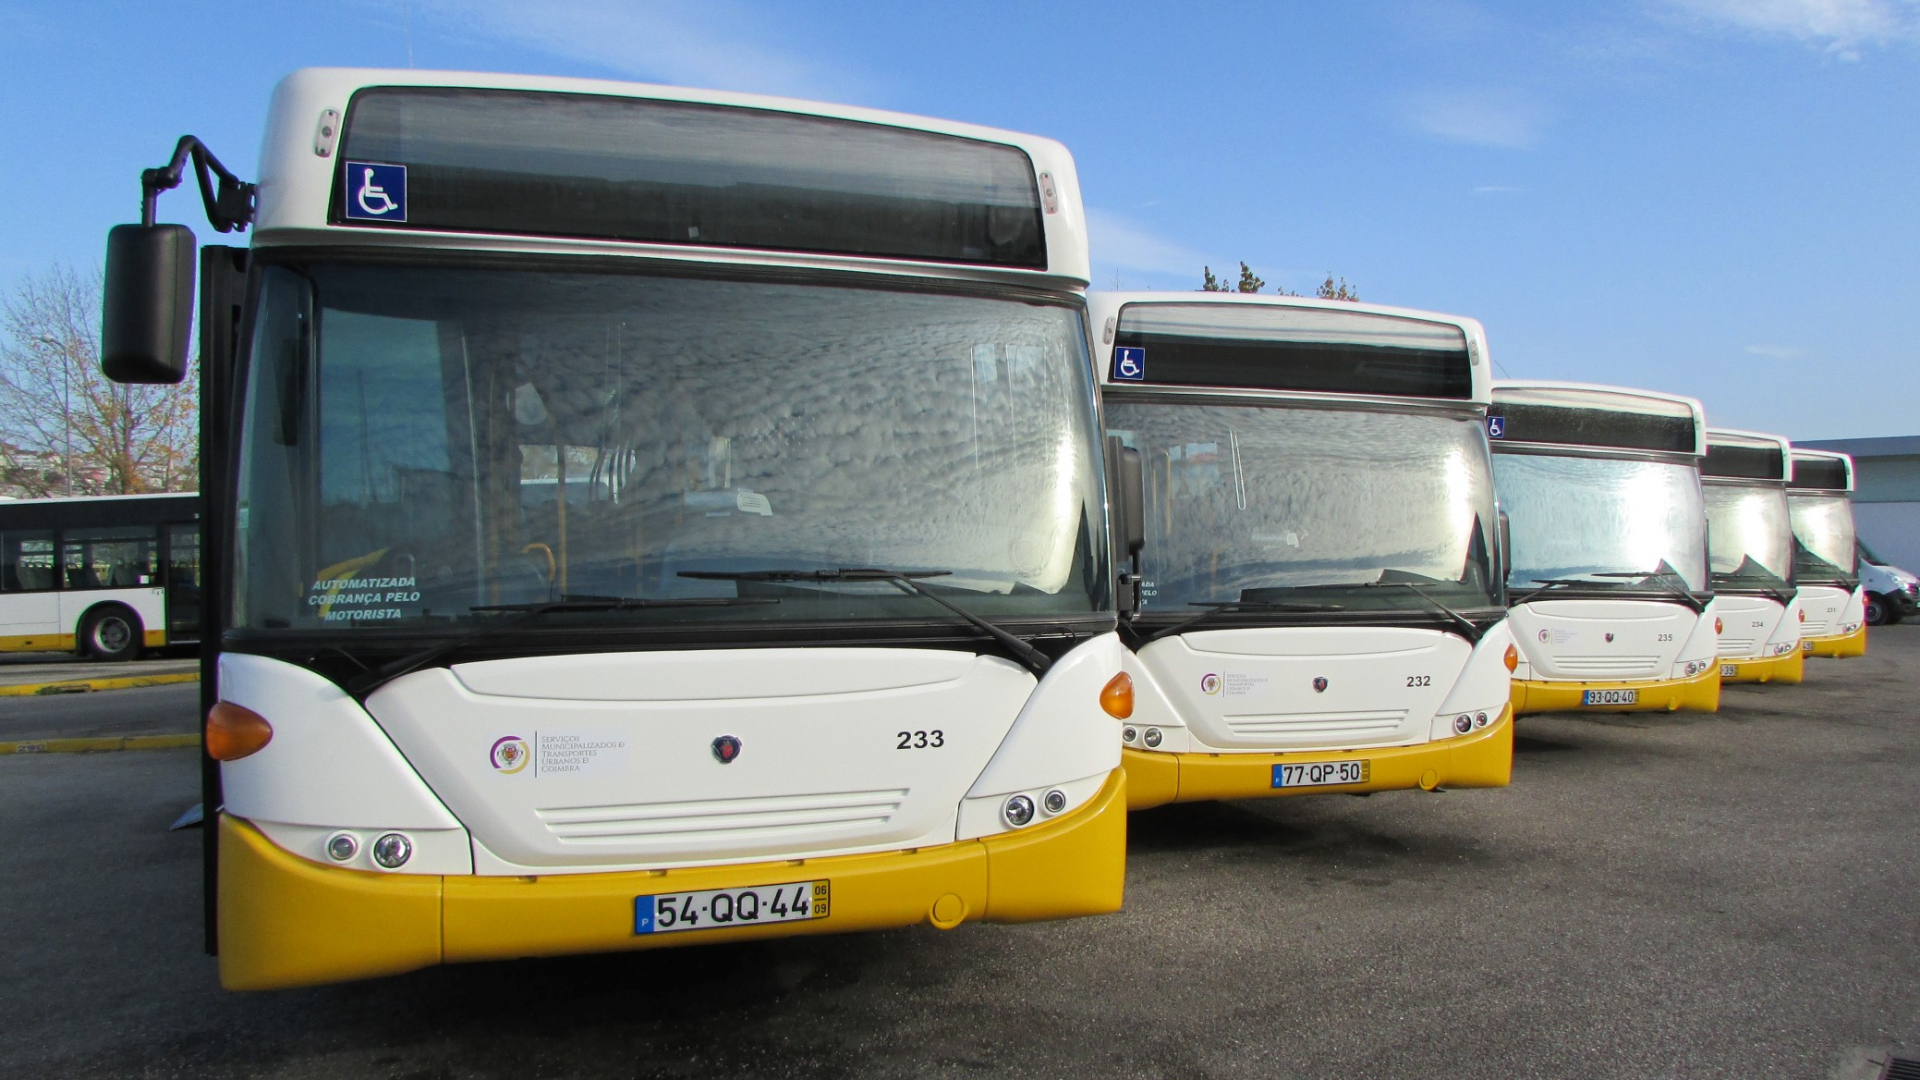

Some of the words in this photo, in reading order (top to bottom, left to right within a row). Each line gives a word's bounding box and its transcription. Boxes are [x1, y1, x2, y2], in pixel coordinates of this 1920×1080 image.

[311, 577, 416, 590] AUTOMATIZADA
[308, 593, 382, 605] COBRANÇA
[385, 592, 420, 602] PELO
[325, 609, 402, 621] MOTORISTA
[1657, 633, 1673, 641] 235
[1406, 675, 1431, 687] 232
[541, 735, 580, 743] SERVIÇOS
[896, 729, 945, 750] 233
[541, 741, 617, 750] MUNICIPALIZADOS
[541, 750, 597, 758] TRANSPORTES
[541, 757, 581, 765] URBANOS
[541, 765, 580, 773] COIMBRA
[815, 885, 826, 895] 06
[815, 904, 826, 914] 09
[641, 919, 649, 927] P
